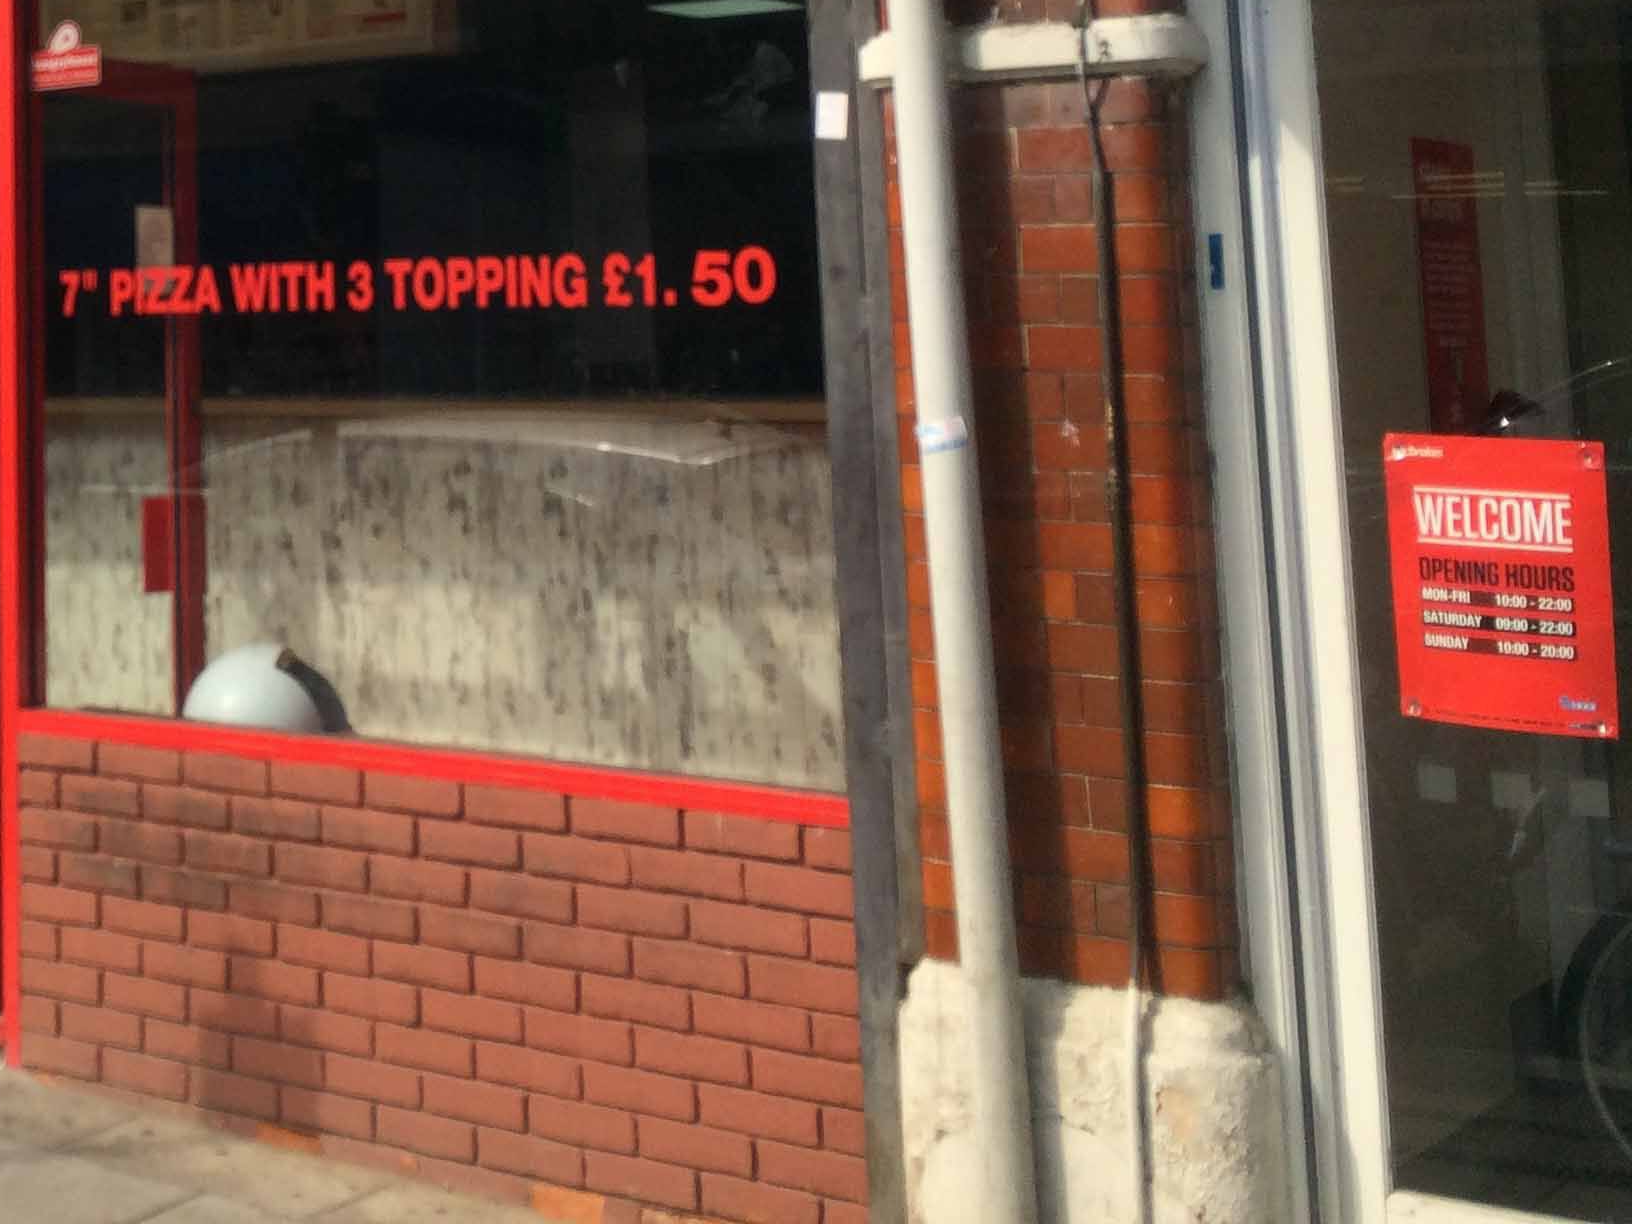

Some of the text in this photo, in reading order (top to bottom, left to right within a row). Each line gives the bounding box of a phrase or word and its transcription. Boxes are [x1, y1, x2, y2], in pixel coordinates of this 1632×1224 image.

[58, 269, 98, 317] 7"
[110, 264, 223, 316] PIZZA
[229, 260, 336, 314] WITH
[346, 260, 374, 312] 3
[384, 254, 589, 312] TOPPING
[1414, 493, 1573, 546] WELCOME
[1419, 557, 1575, 592] OPENING HOURS
[1422, 587, 1470, 604] MON-FRI
[1494, 594, 1527, 609] 10:00
[1538, 597, 1572, 612] 22:00
[1423, 609, 1482, 628] SATURDAY
[1539, 620, 1573, 636] 22:00
[1424, 633, 1469, 650] SUNDAY
[1496, 640, 1529, 656] 10:00
[1540, 644, 1575, 660] 20:00
